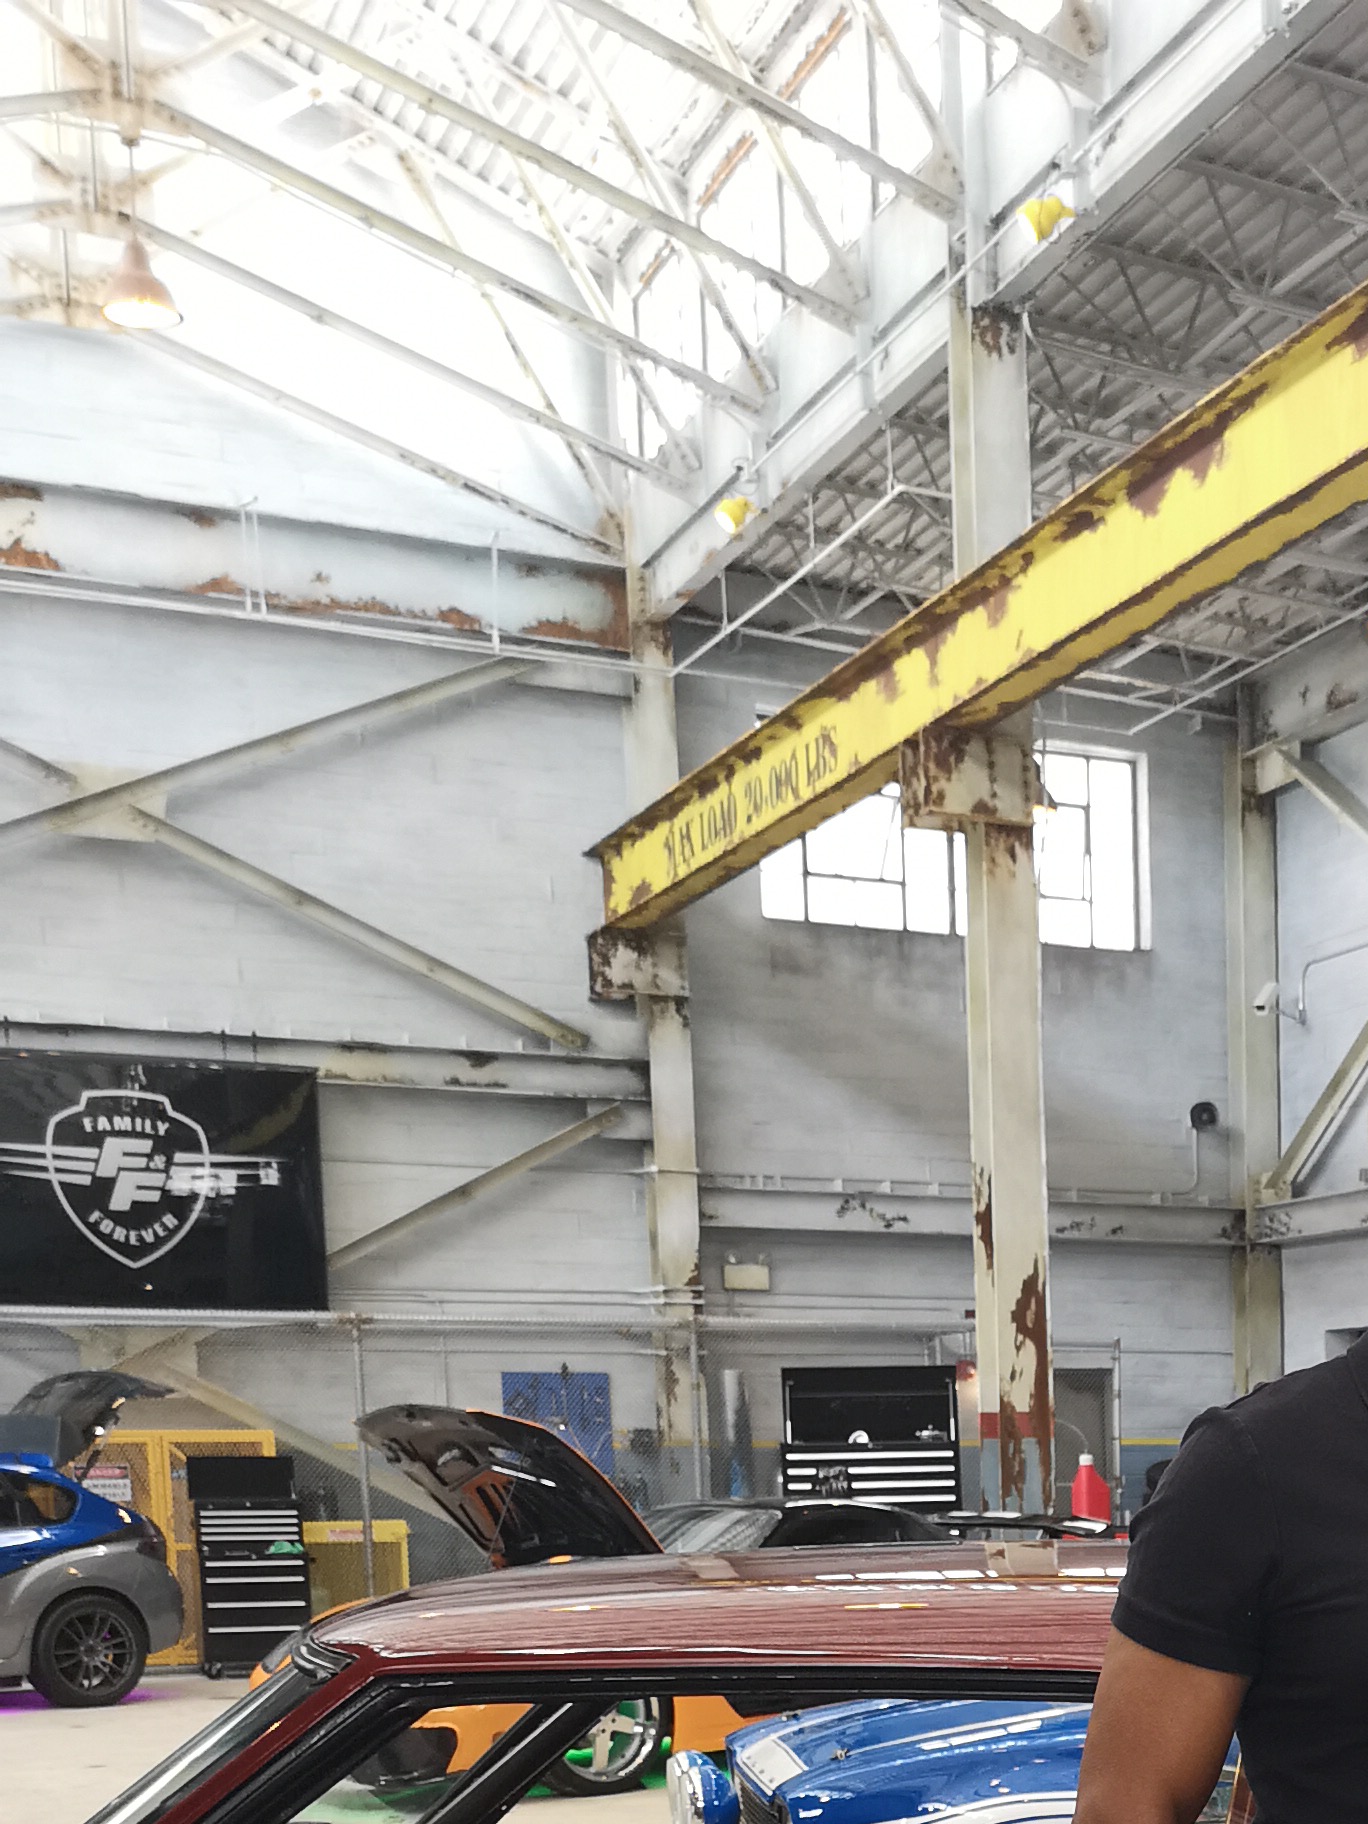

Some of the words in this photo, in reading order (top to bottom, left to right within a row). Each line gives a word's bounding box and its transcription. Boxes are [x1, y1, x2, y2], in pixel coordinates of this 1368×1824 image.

[700, 792, 737, 851] LOAD
[805, 726, 838, 788] LBS
[82, 1116, 170, 1136] FAMILY
[88, 1209, 180, 1246] FOREVER
